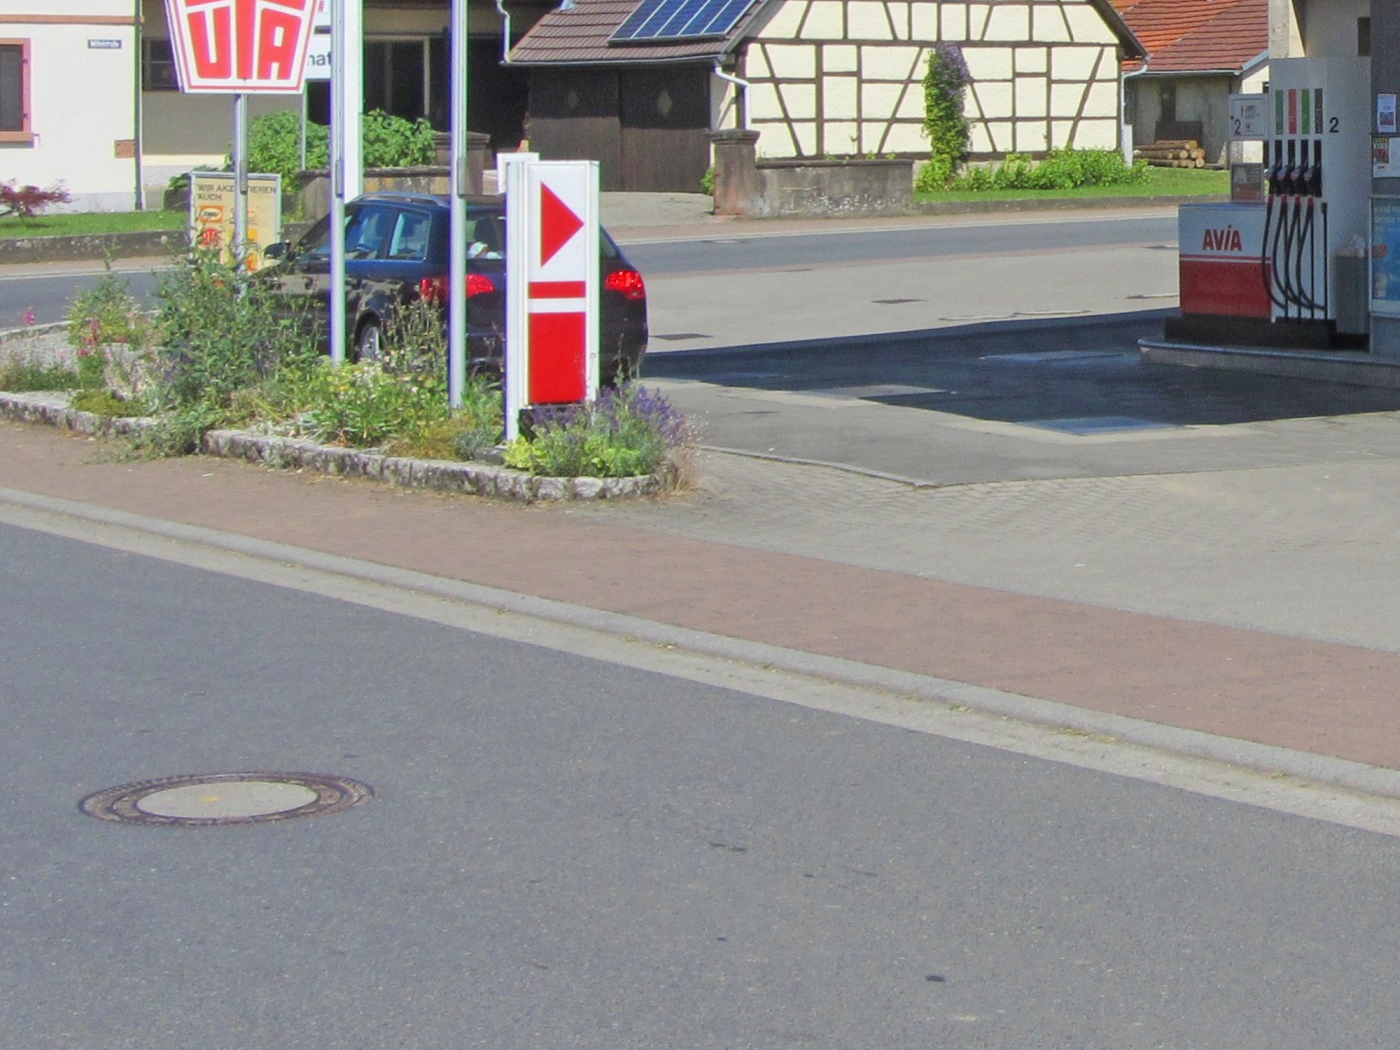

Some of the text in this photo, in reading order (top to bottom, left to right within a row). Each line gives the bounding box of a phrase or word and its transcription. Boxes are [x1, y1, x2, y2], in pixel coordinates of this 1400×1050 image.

[1234, 119, 1241, 135] 2
[1329, 116, 1340, 134] 2
[197, 184, 214, 192] WIR
[197, 193, 222, 201] AUCH
